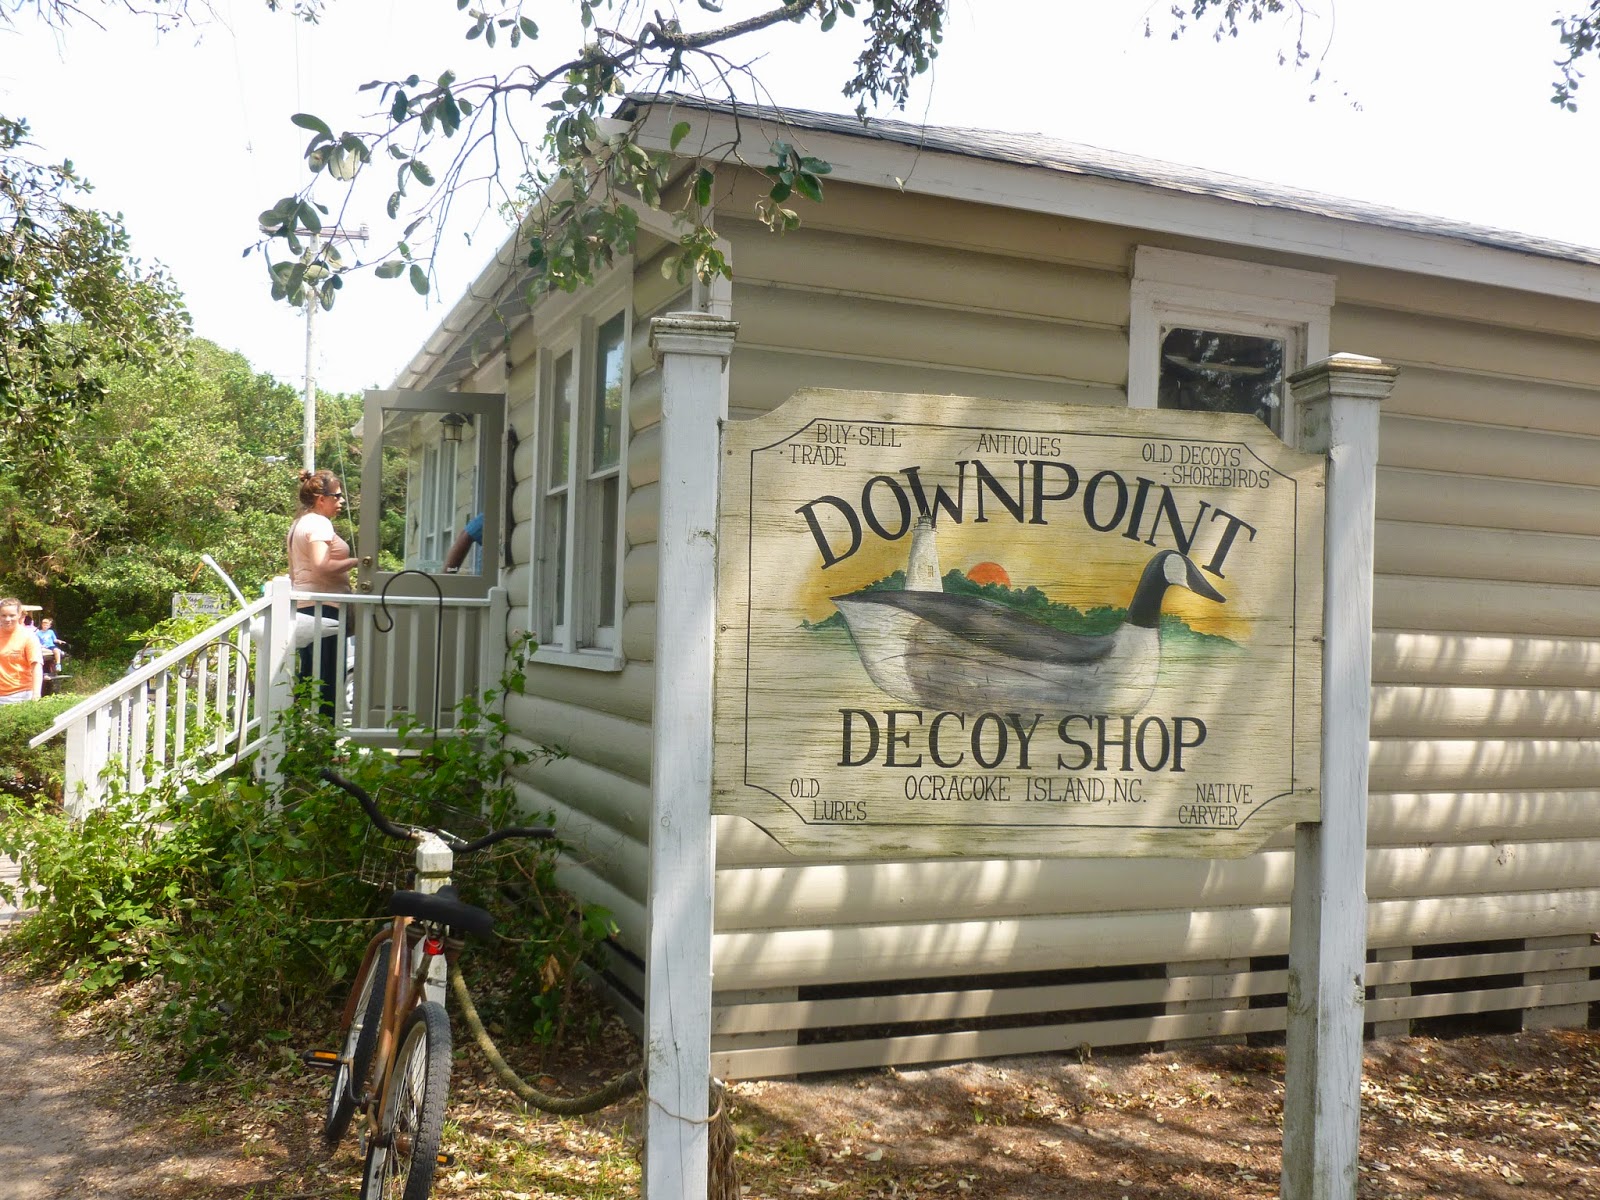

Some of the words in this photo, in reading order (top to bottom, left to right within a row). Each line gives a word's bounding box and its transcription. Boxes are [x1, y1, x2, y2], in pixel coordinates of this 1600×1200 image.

[789, 444, 847, 466] TRADE
[977, 434, 1061, 457] ANTIQUES
[1142, 444, 1173, 462] OLD
[1181, 446, 1241, 467] DECOYS
[1172, 465, 1270, 489] SHOREBIRDS
[795, 459, 1257, 579] DOWNPOINT
[837, 708, 1044, 770] DECOY
[1057, 714, 1207, 772] SHOP
[790, 778, 820, 798] OLD
[904, 775, 1010, 801] OCRACOKE
[1196, 783, 1253, 804] NATIVE
[813, 801, 867, 821] LURES
[1178, 805, 1238, 826] CARVER
